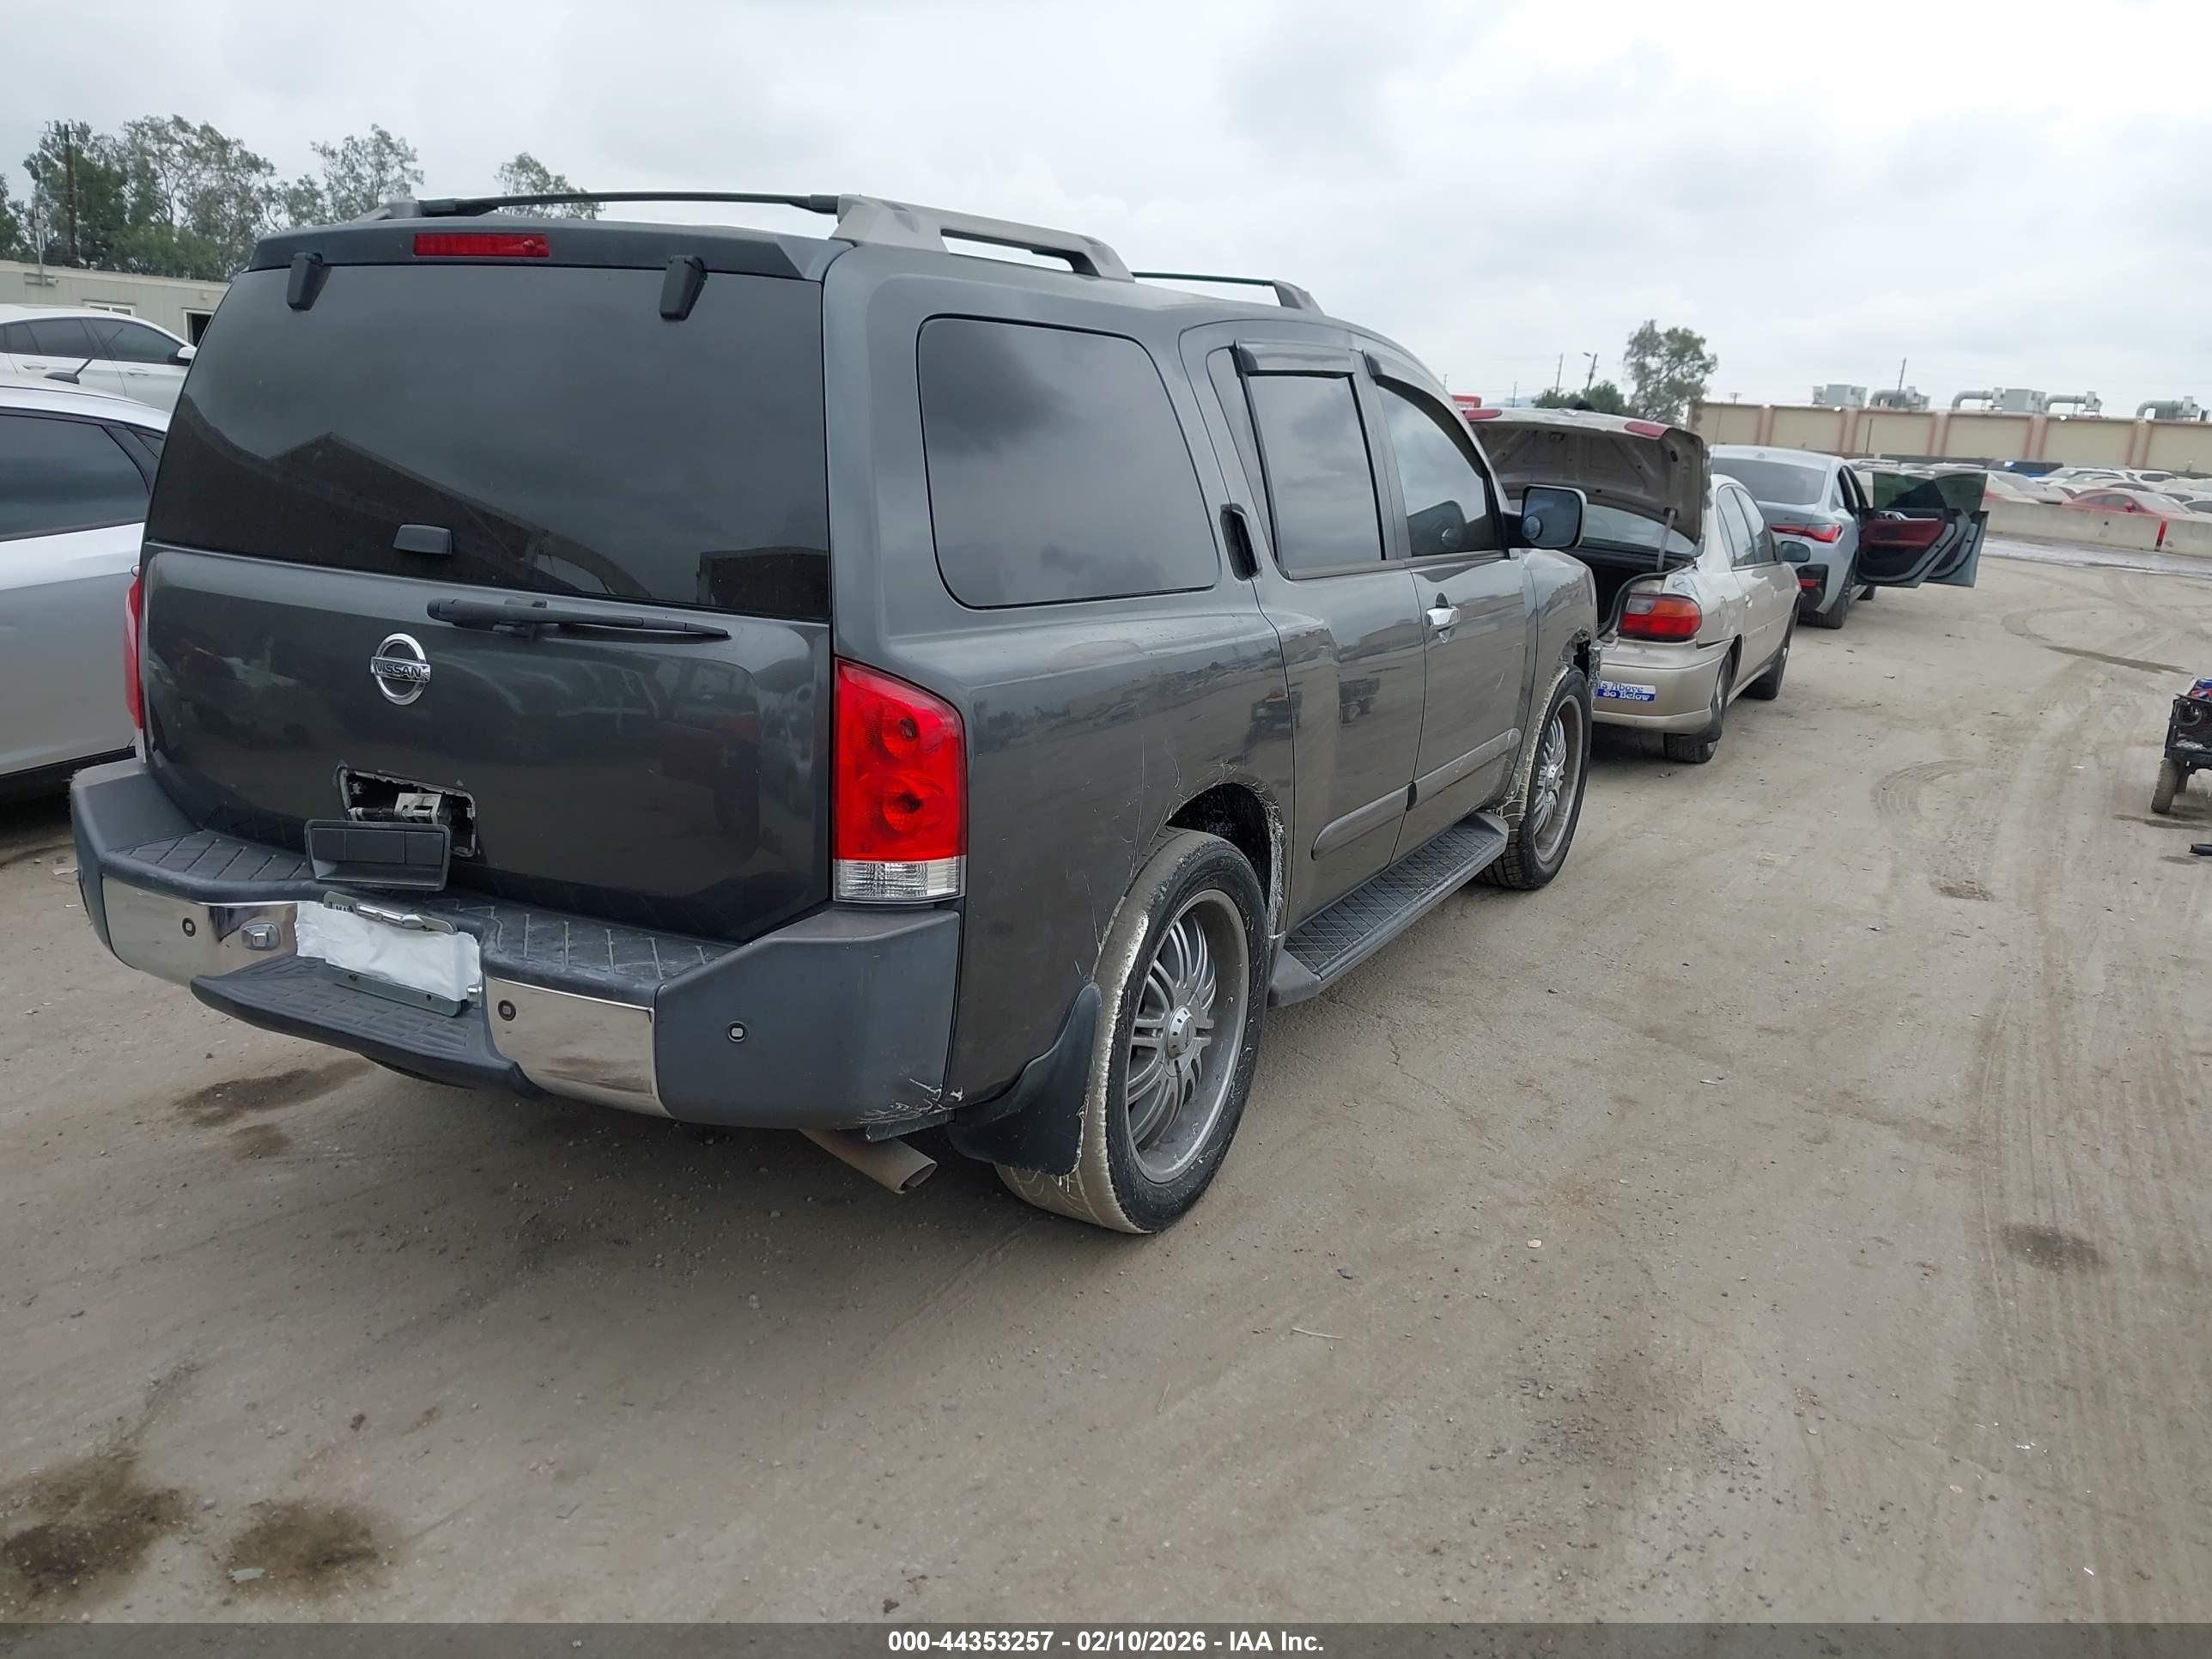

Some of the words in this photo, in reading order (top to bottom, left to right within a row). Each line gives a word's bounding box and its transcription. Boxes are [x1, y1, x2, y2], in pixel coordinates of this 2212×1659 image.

[374, 660, 422, 679] NISSAN
[1610, 683, 1644, 693] Above
[1620, 691, 1650, 701] Below
